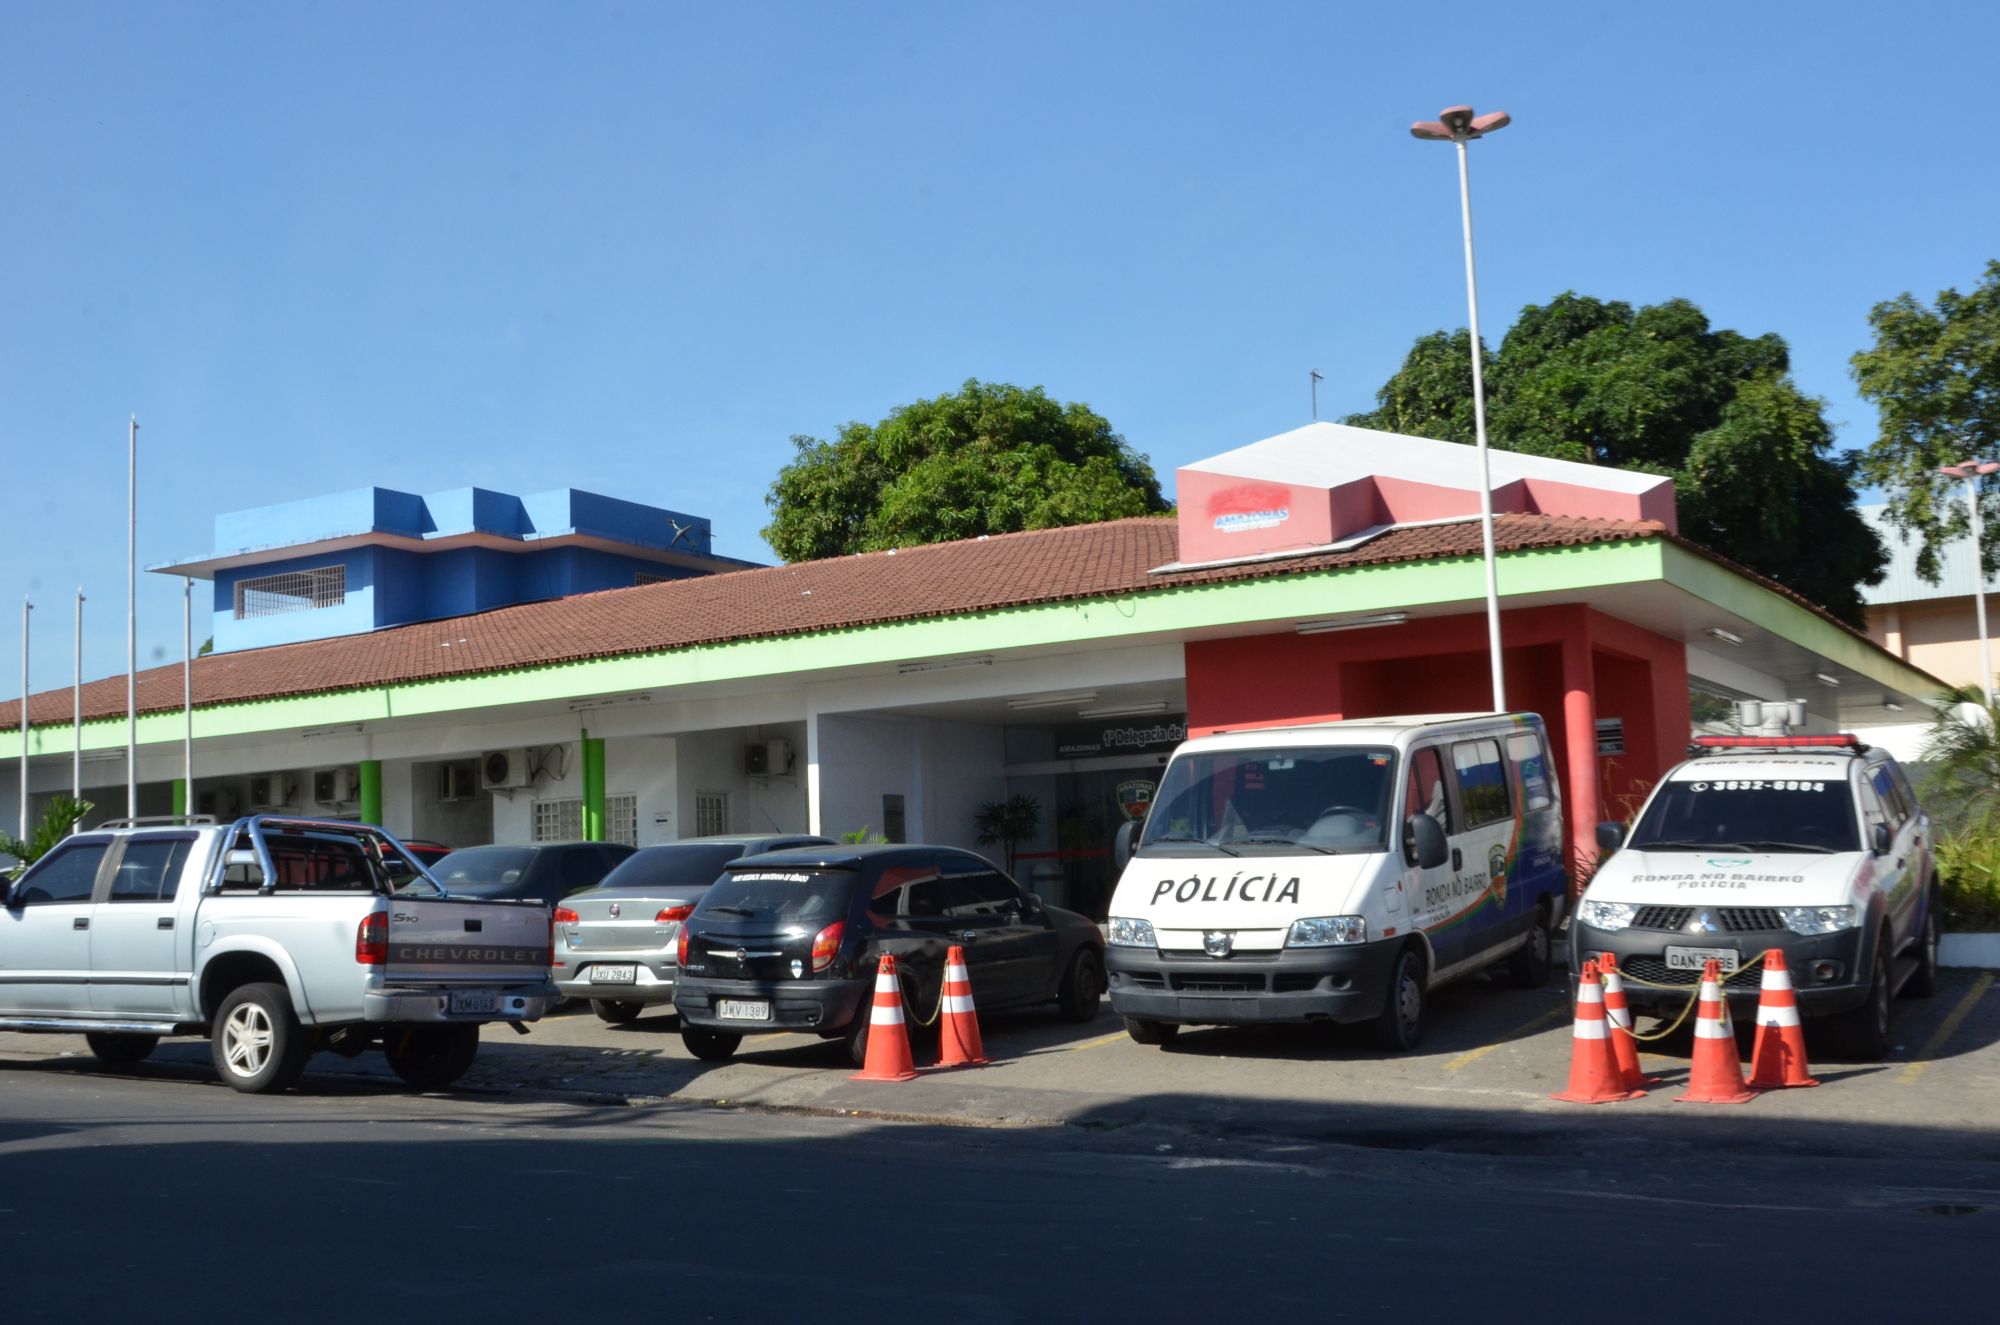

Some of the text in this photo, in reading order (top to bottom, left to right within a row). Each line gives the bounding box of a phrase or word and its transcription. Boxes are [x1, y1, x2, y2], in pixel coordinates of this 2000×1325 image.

[1215, 508, 1288, 527] AMAZONAS
[1116, 725, 1167, 747] Delegacia
[1168, 724, 1183, 741] de
[1059, 743, 1101, 753] AMAZONAS
[1632, 873, 1695, 883] RONDA
[1732, 873, 1805, 883] BAIRRO
[1150, 871, 1300, 906] POLÍCIA
[1425, 882, 1450, 908] RONDA
[1463, 871, 1488, 896] BAIRRO
[393, 913, 419, 924] S10
[400, 948, 540, 961] CHEVROLET
